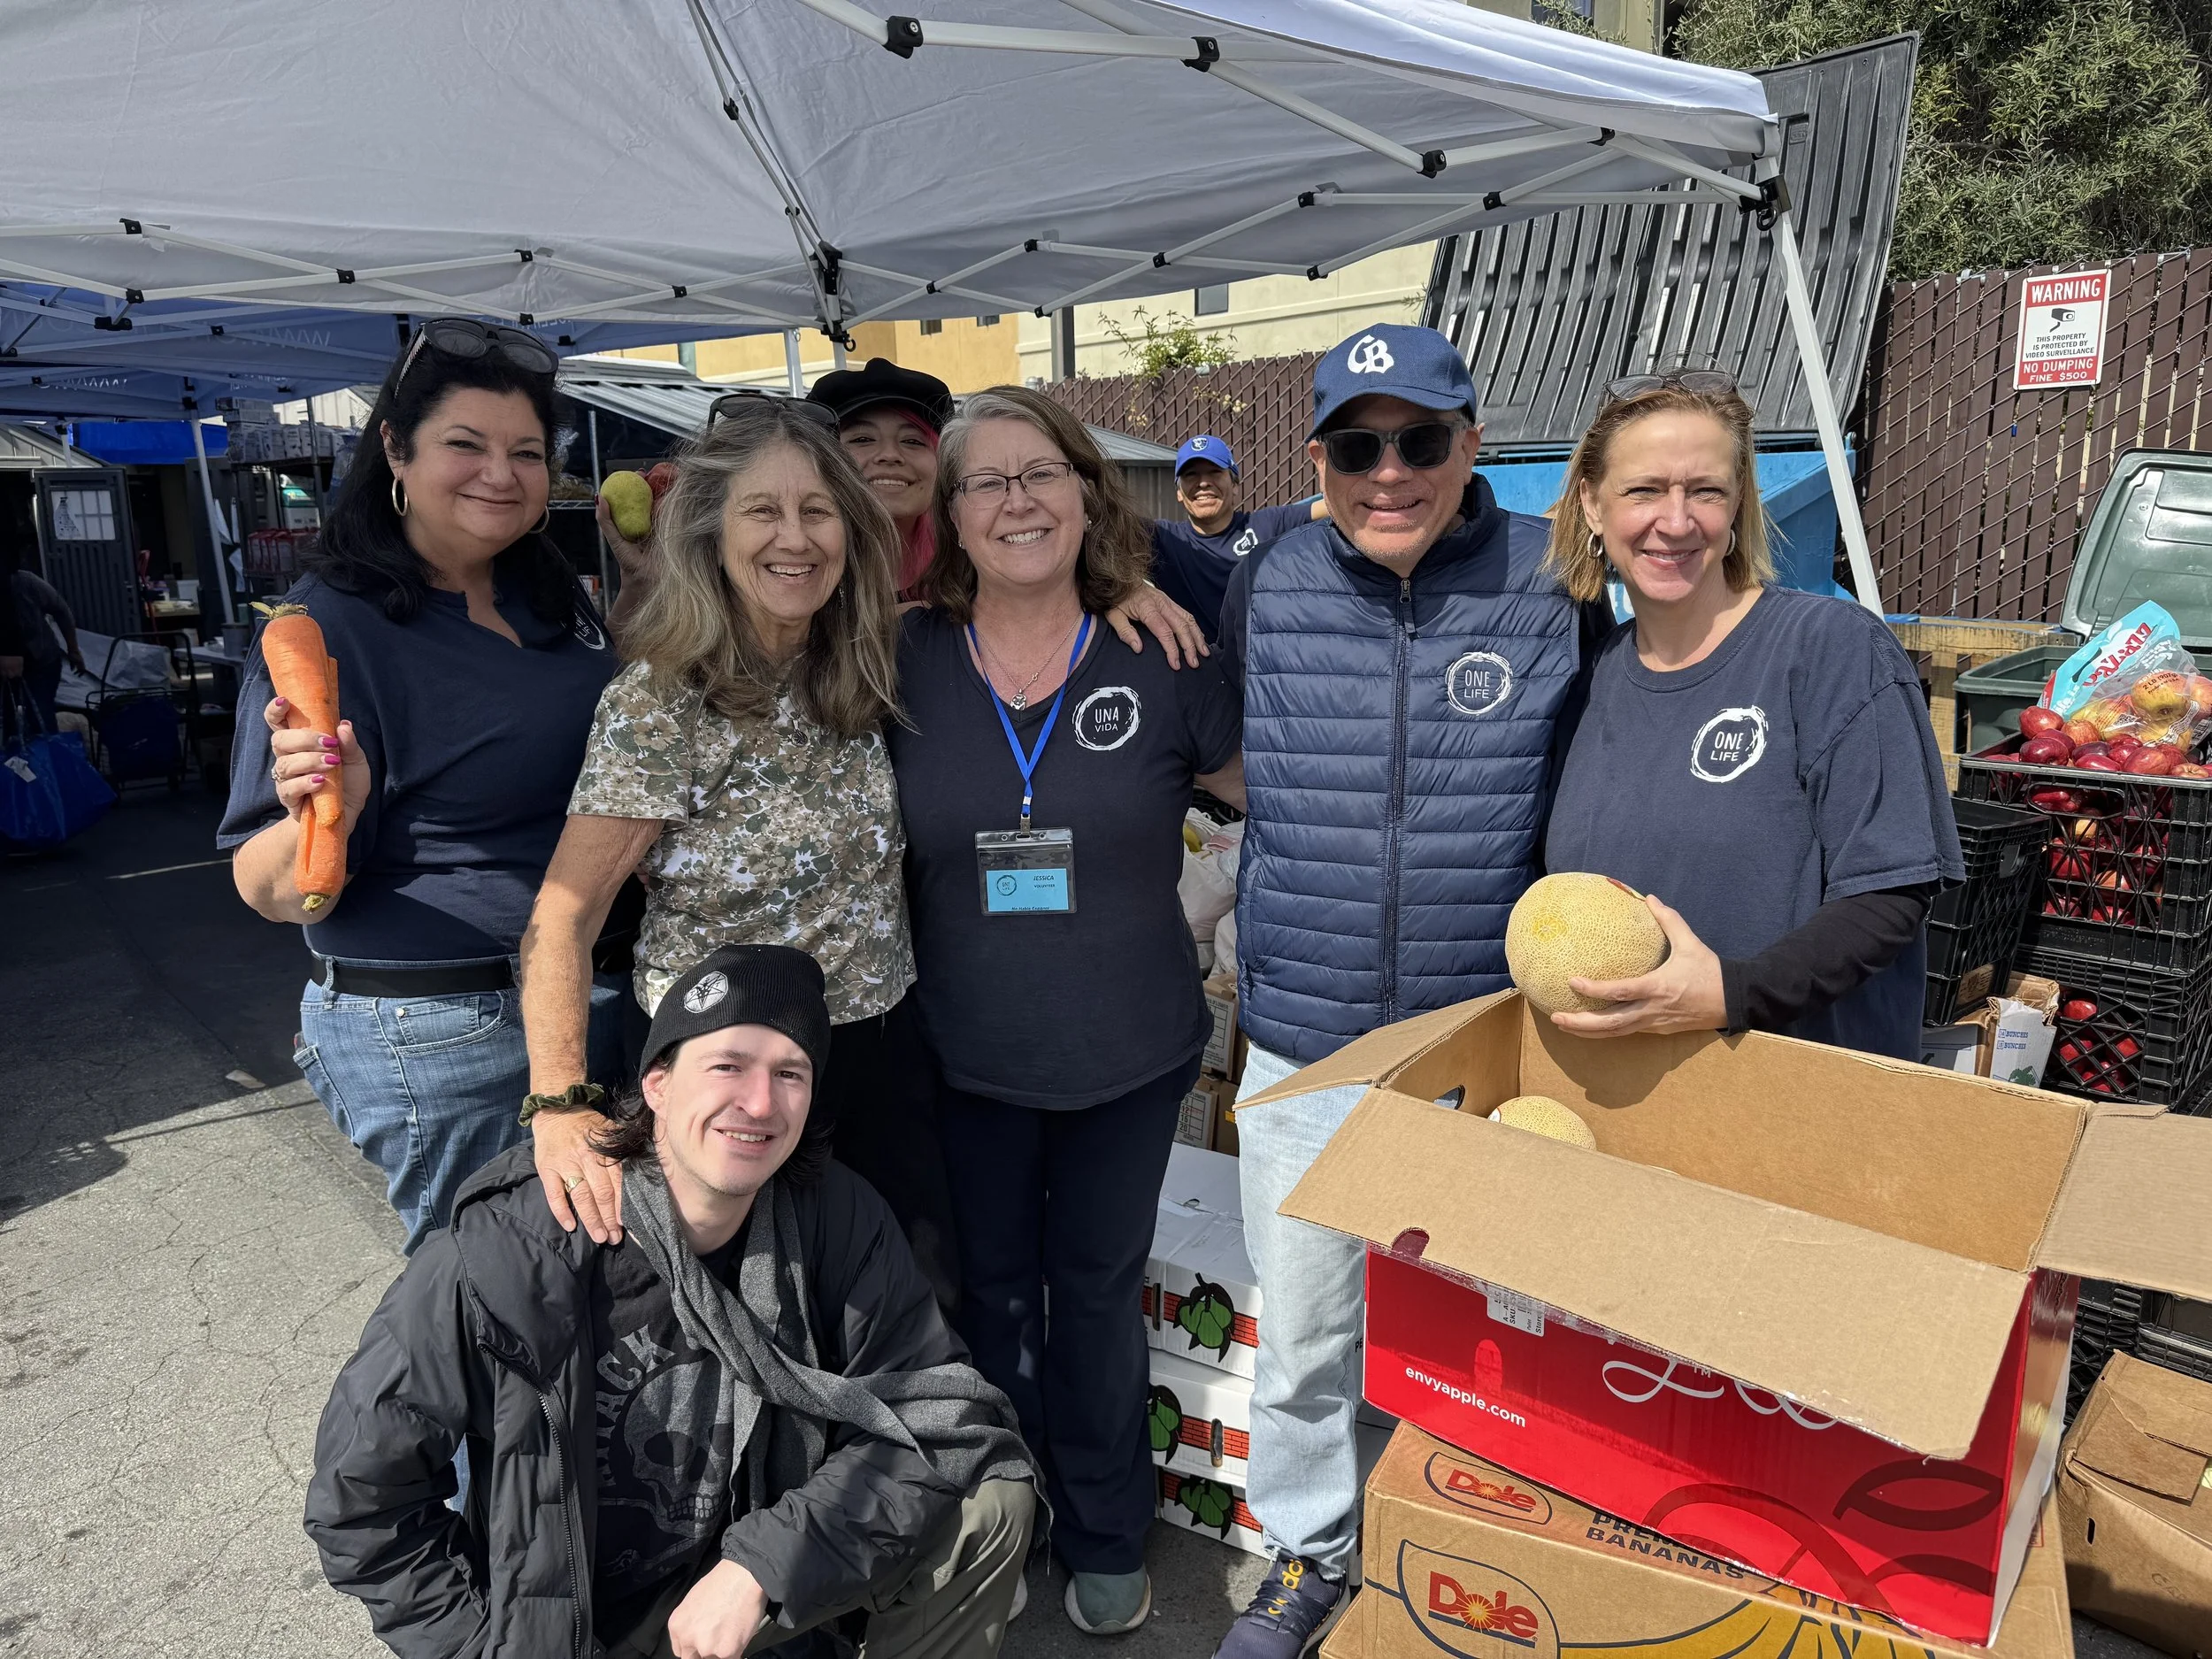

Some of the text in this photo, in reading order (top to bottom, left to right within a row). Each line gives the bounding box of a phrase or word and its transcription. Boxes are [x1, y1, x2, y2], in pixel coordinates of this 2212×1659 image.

[2032, 278, 2101, 303] WARNING
[2052, 333, 2086, 342] PROPERTY
[2040, 341, 2078, 349] PROTECTED
[2046, 347, 2094, 357] SURVEILLANCE
[2023, 358, 2093, 373] NO DUMPING
[2029, 372, 2087, 383] FINE $500
[1464, 669, 1491, 687] ONE
[1463, 688, 1489, 699] LIFE
[1094, 707, 1119, 724] UNA
[1094, 723, 1118, 733] VIDA
[1715, 731, 1744, 750] ONE
[1710, 750, 1740, 762] LIFE
[1181, 1105, 1189, 1114] 12
[1179, 1123, 1188, 1133] 20
[1405, 1367, 1526, 1427] envyapple.com
[1445, 1469, 1537, 1508] Dole
[1586, 1526, 1745, 1579] BANANAS
[1429, 1571, 1539, 1639] Dole
